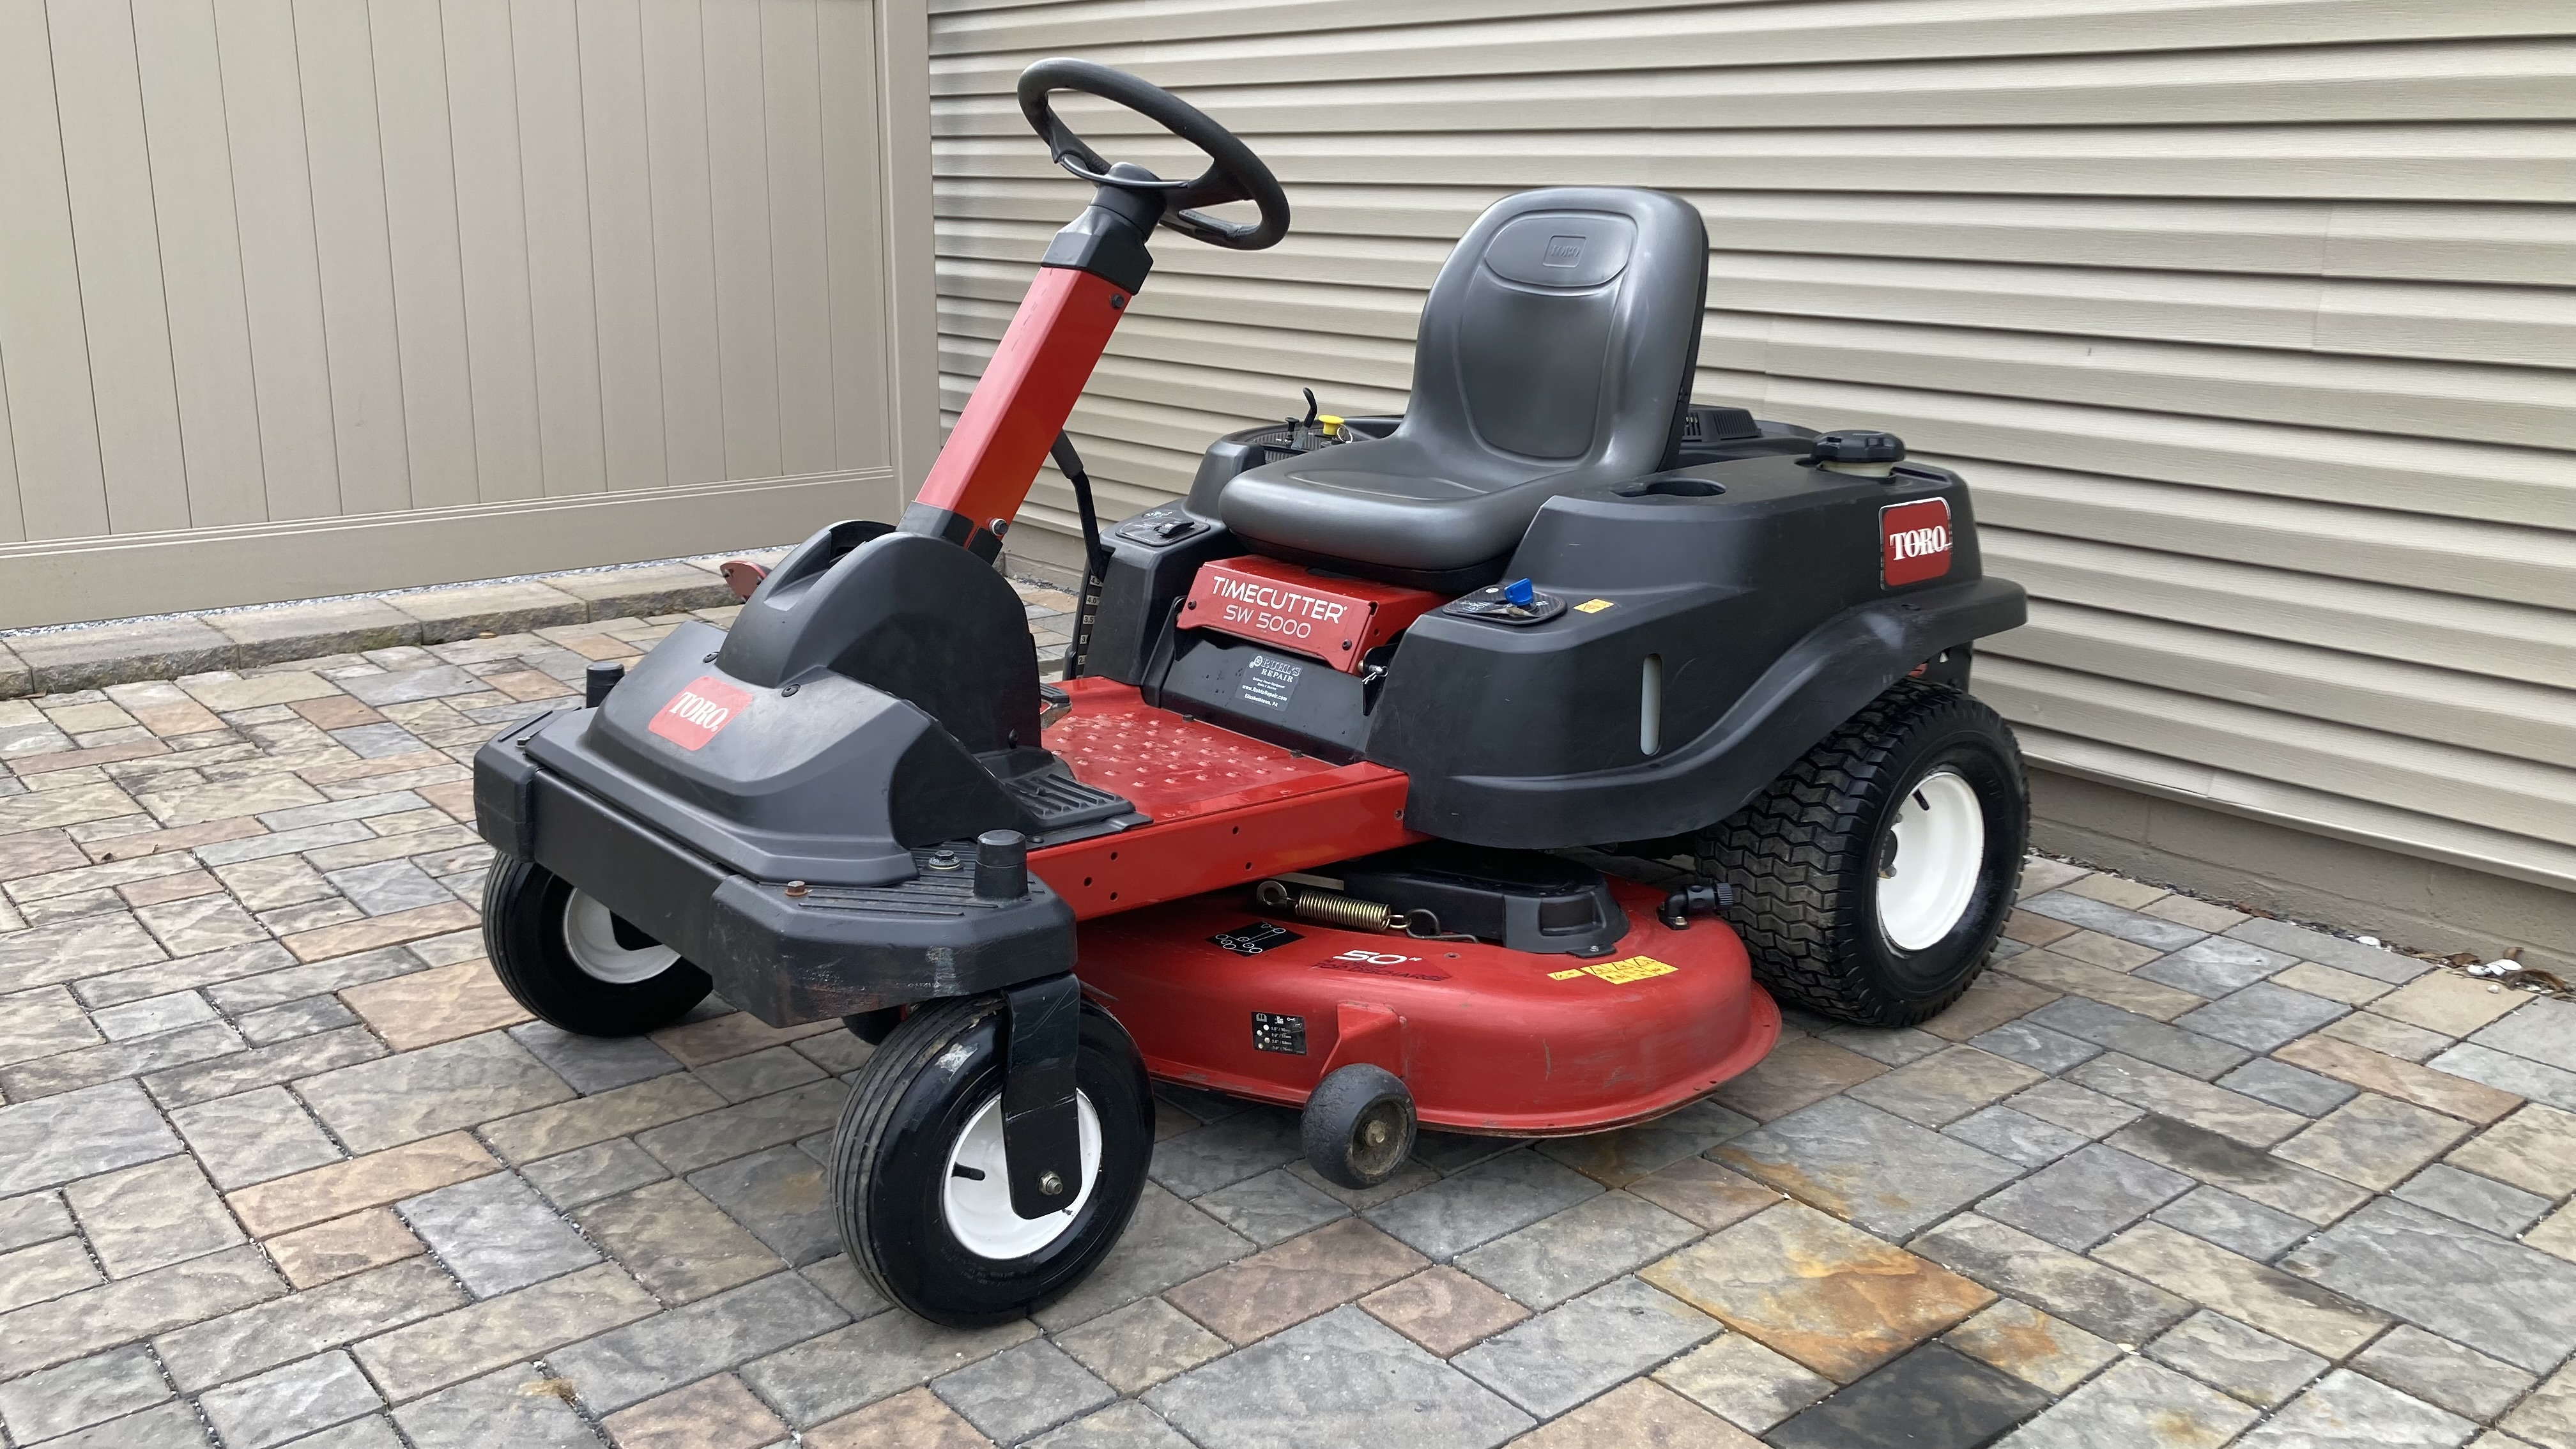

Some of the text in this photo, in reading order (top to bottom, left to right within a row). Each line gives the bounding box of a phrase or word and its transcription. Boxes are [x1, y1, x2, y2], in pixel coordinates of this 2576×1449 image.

[1551, 245, 1581, 258] TORO
[1889, 525, 1947, 561] TORO
[1213, 576, 1346, 625] TIMECUTTER
[1223, 604, 1312, 639] SW 5000
[1261, 668, 1294, 683] REPAIR
[669, 691, 729, 730] TORO
